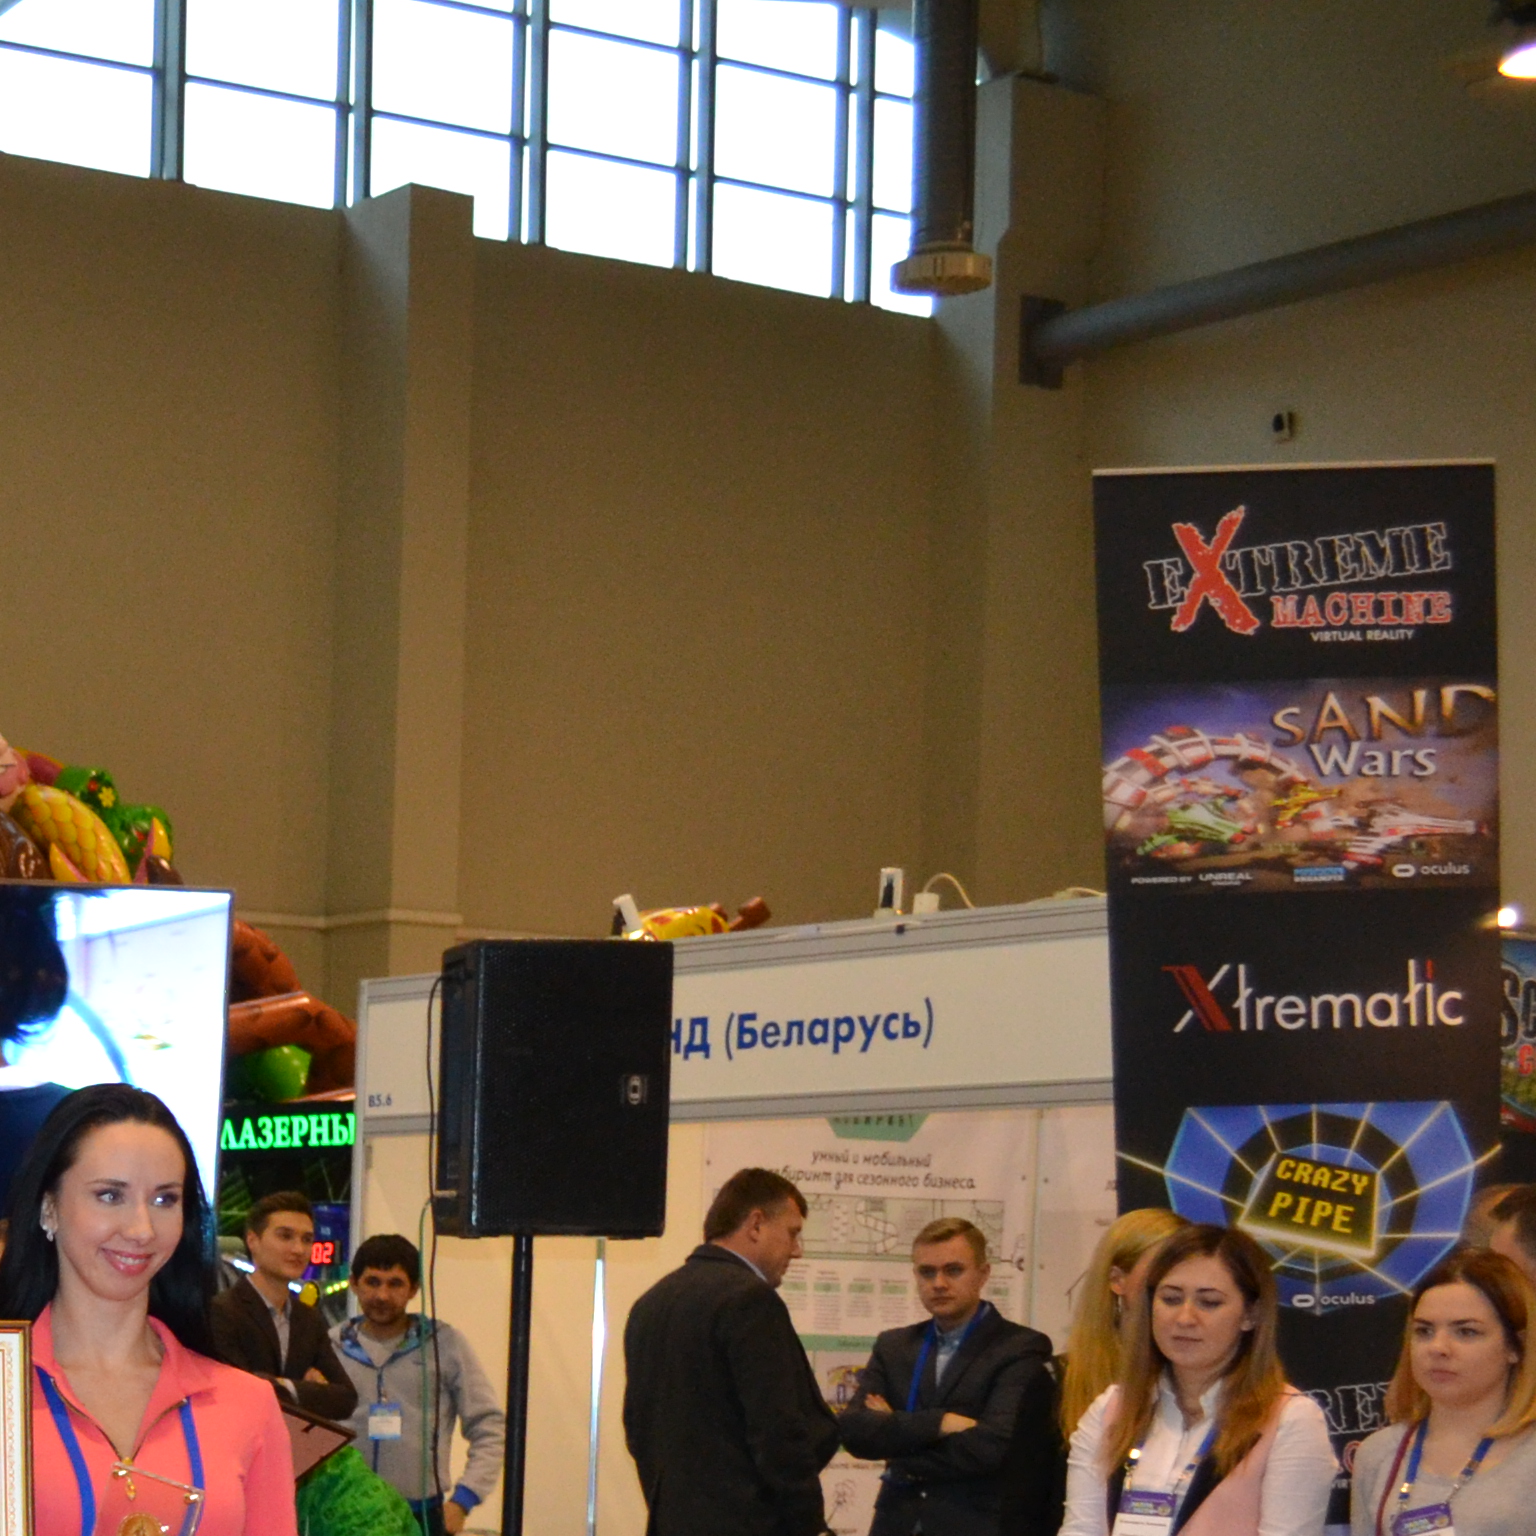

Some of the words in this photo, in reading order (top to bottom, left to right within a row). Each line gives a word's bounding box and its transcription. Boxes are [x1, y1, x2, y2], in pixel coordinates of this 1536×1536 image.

[1143, 505, 1451, 635] EXTREME
[1270, 591, 1451, 627] MACHINE
[1311, 631, 1362, 641] VIRTUAL
[1366, 629, 1414, 640] REALITY
[1273, 684, 1496, 746] SAND
[1309, 741, 1436, 776] Wars
[1199, 871, 1253, 882] UNREAL
[1421, 864, 1470, 875] oculus
[1161, 958, 1465, 1033] Xtrematic
[671, 1017, 711, 1060] НД
[725, 997, 934, 1061] (Беларусь)
[220, 1112, 356, 1150] ЛАЗЕРНЫ
[811, 1150, 849, 1165] умный
[862, 1150, 931, 1168] мобильный
[1276, 1158, 1368, 1196] CRAZY
[773, 1166, 832, 1182] абиринт
[835, 1171, 854, 1190] для
[857, 1172, 919, 1188] сезонного
[923, 1170, 976, 1190] бизнеса
[1268, 1191, 1355, 1233] PIPE
[1320, 1292, 1375, 1305] oculus
